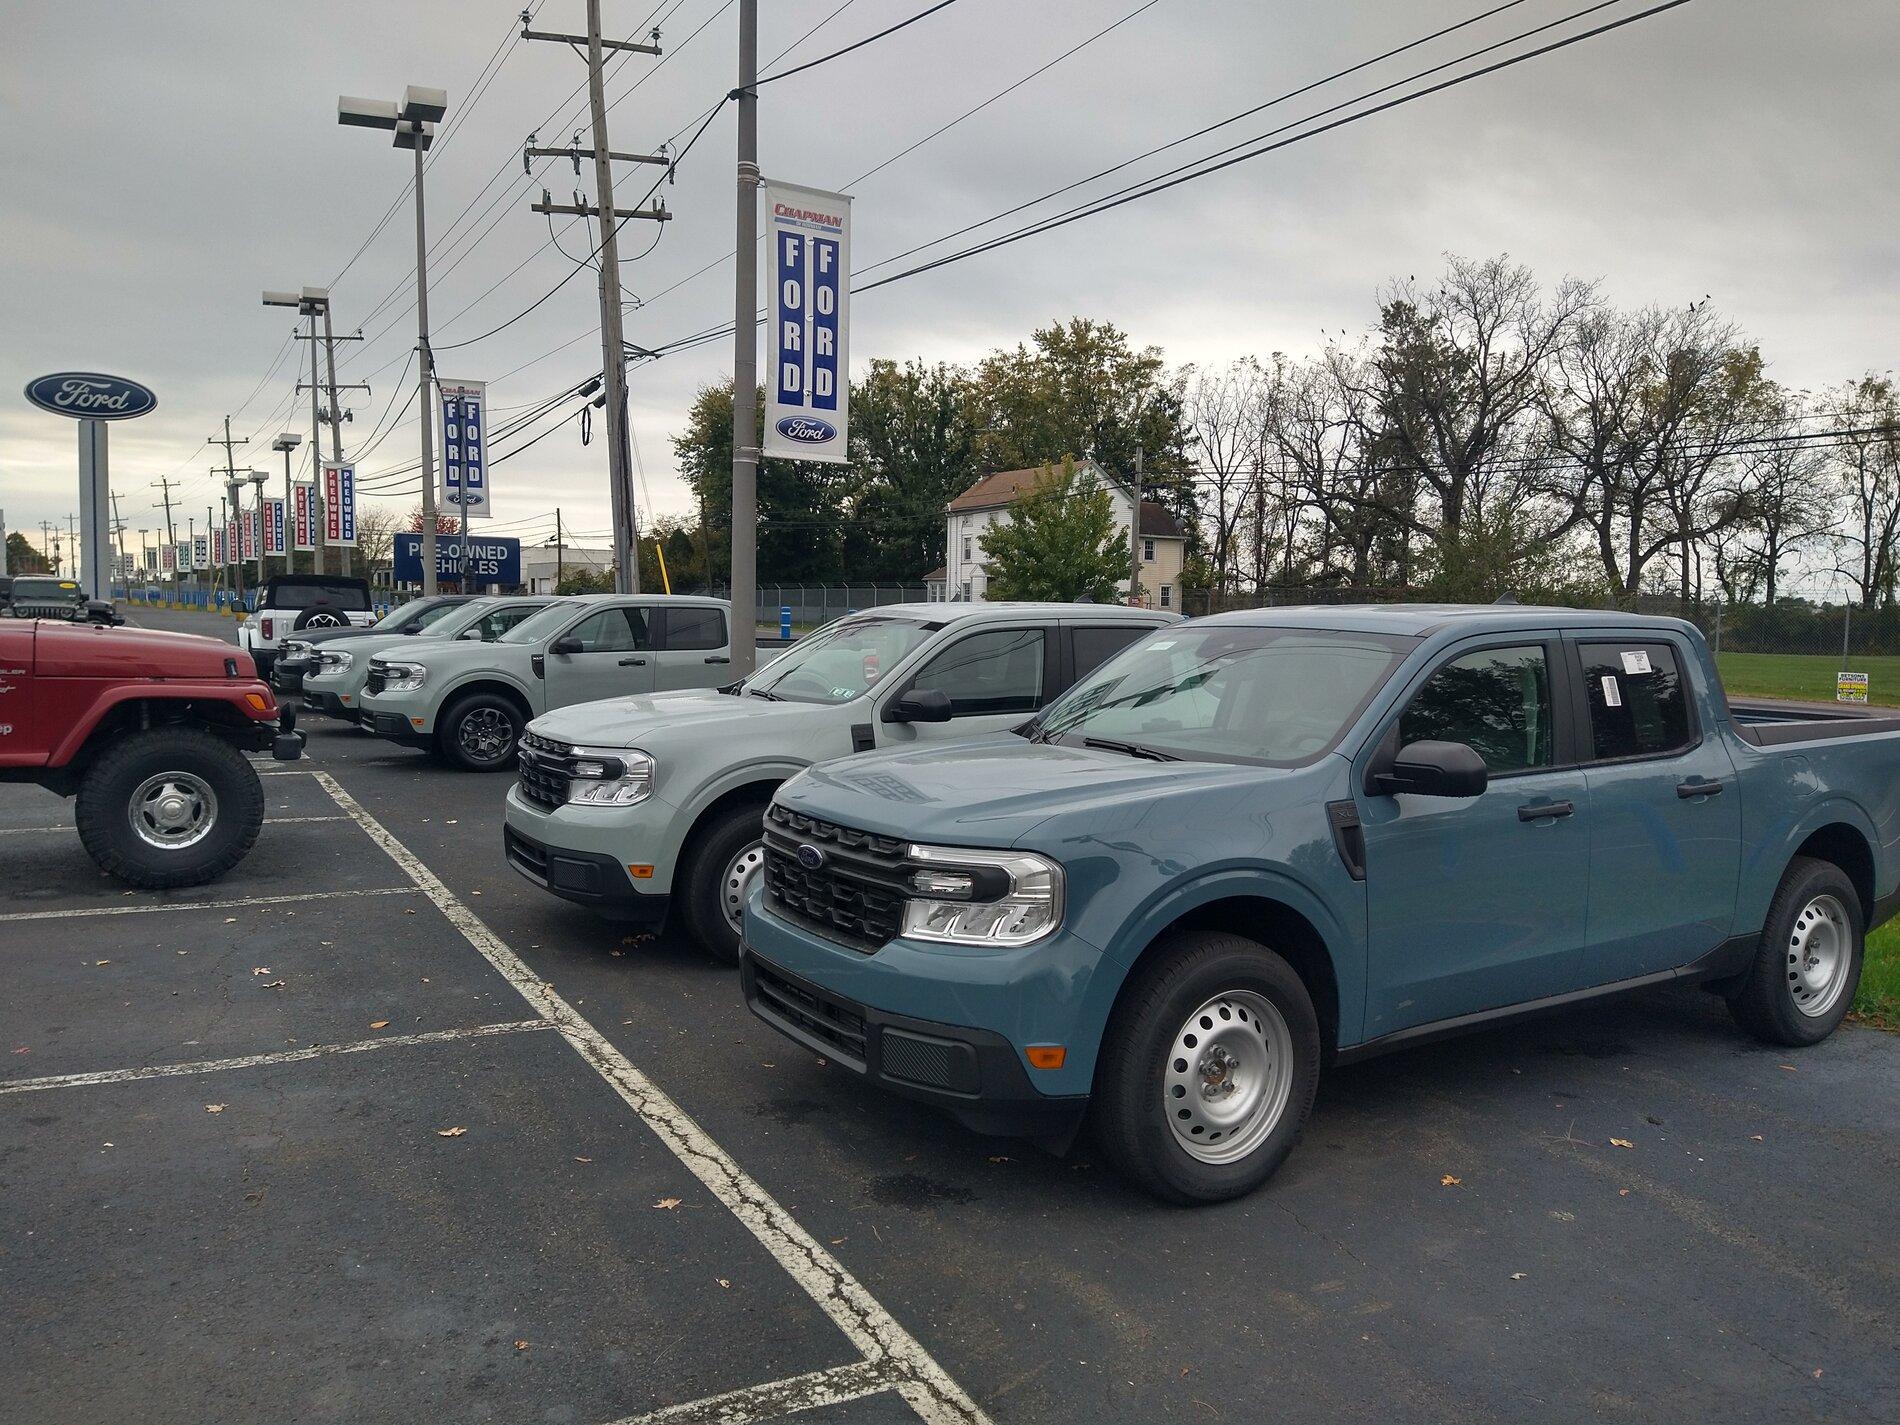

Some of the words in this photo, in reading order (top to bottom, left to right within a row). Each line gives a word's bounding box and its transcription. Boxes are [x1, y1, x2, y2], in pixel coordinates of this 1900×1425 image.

[774, 203, 842, 227] CHAPMAN
[783, 237, 801, 392] FORD
[816, 244, 834, 396] FORD
[54, 379, 129, 410] Ford
[441, 387, 481, 396] CHAMAN
[447, 403, 459, 480] FORD
[467, 404, 480, 482] FORD
[788, 420, 825, 440] Ford
[329, 471, 337, 538] PREOWNED
[343, 472, 352, 539] PREOWNED
